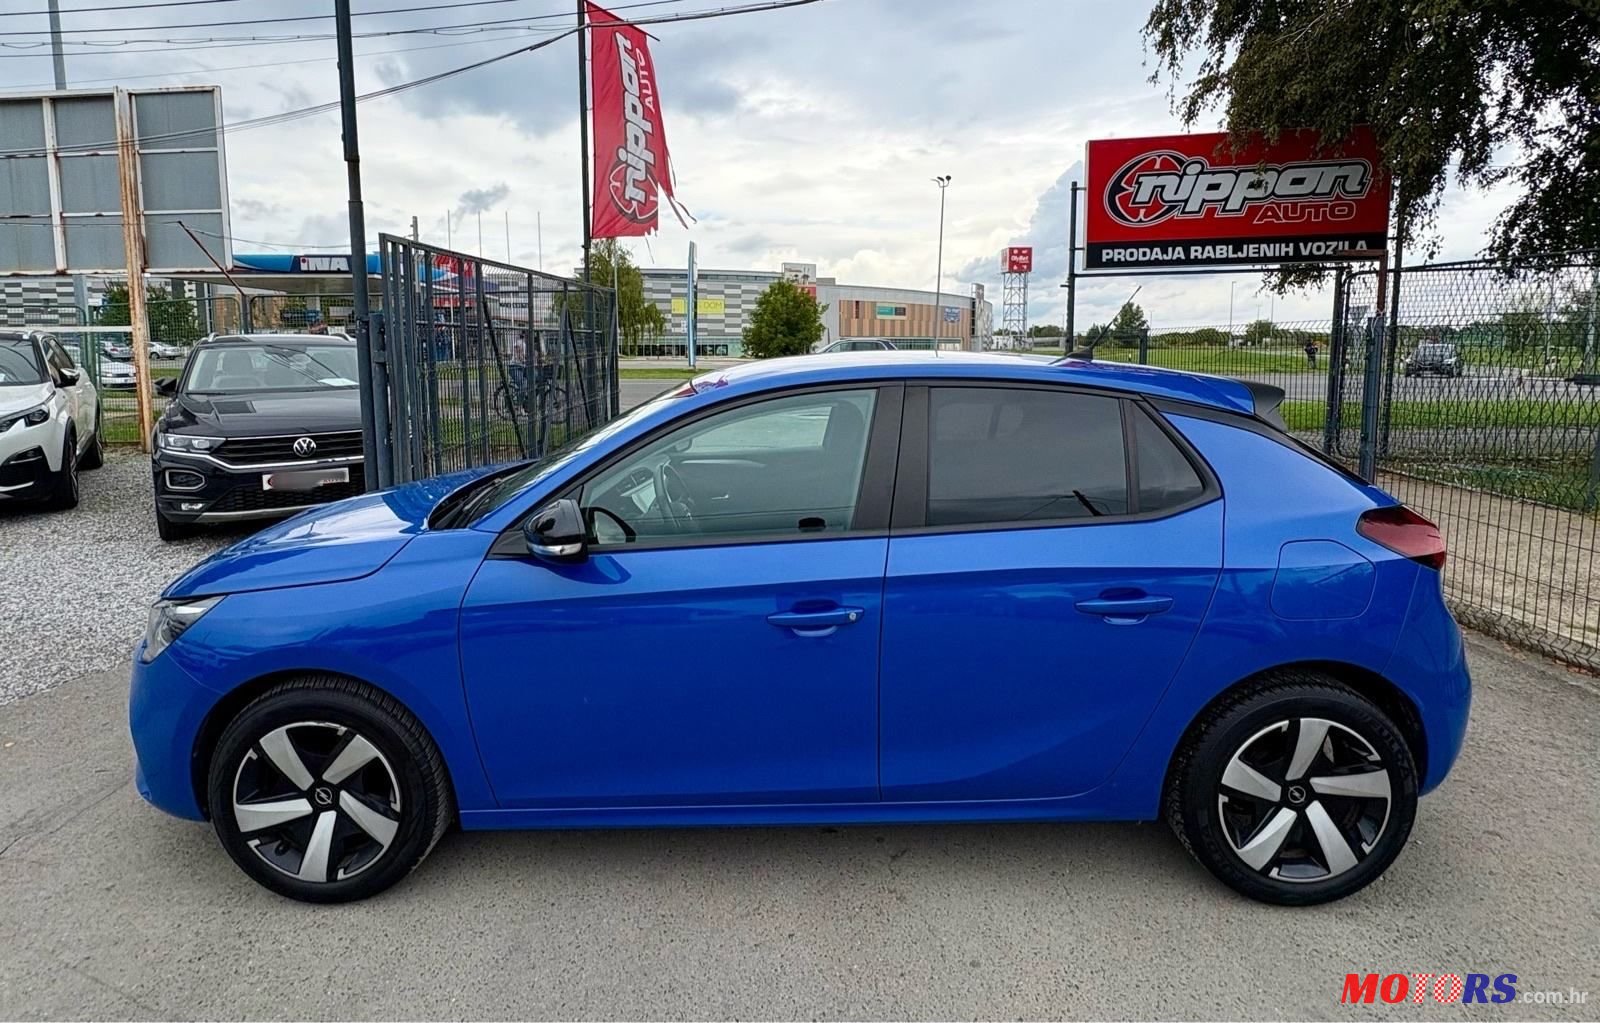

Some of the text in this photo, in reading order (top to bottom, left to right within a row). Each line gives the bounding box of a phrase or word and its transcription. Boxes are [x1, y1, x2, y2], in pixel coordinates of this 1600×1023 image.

[636, 50, 656, 113] AUTO
[615, 31, 655, 205] nippon
[1133, 159, 1370, 213] nippon
[1253, 202, 1356, 224] AUTO
[1101, 245, 1185, 263] PRODAJA
[1191, 243, 1294, 260] RABLJENIH
